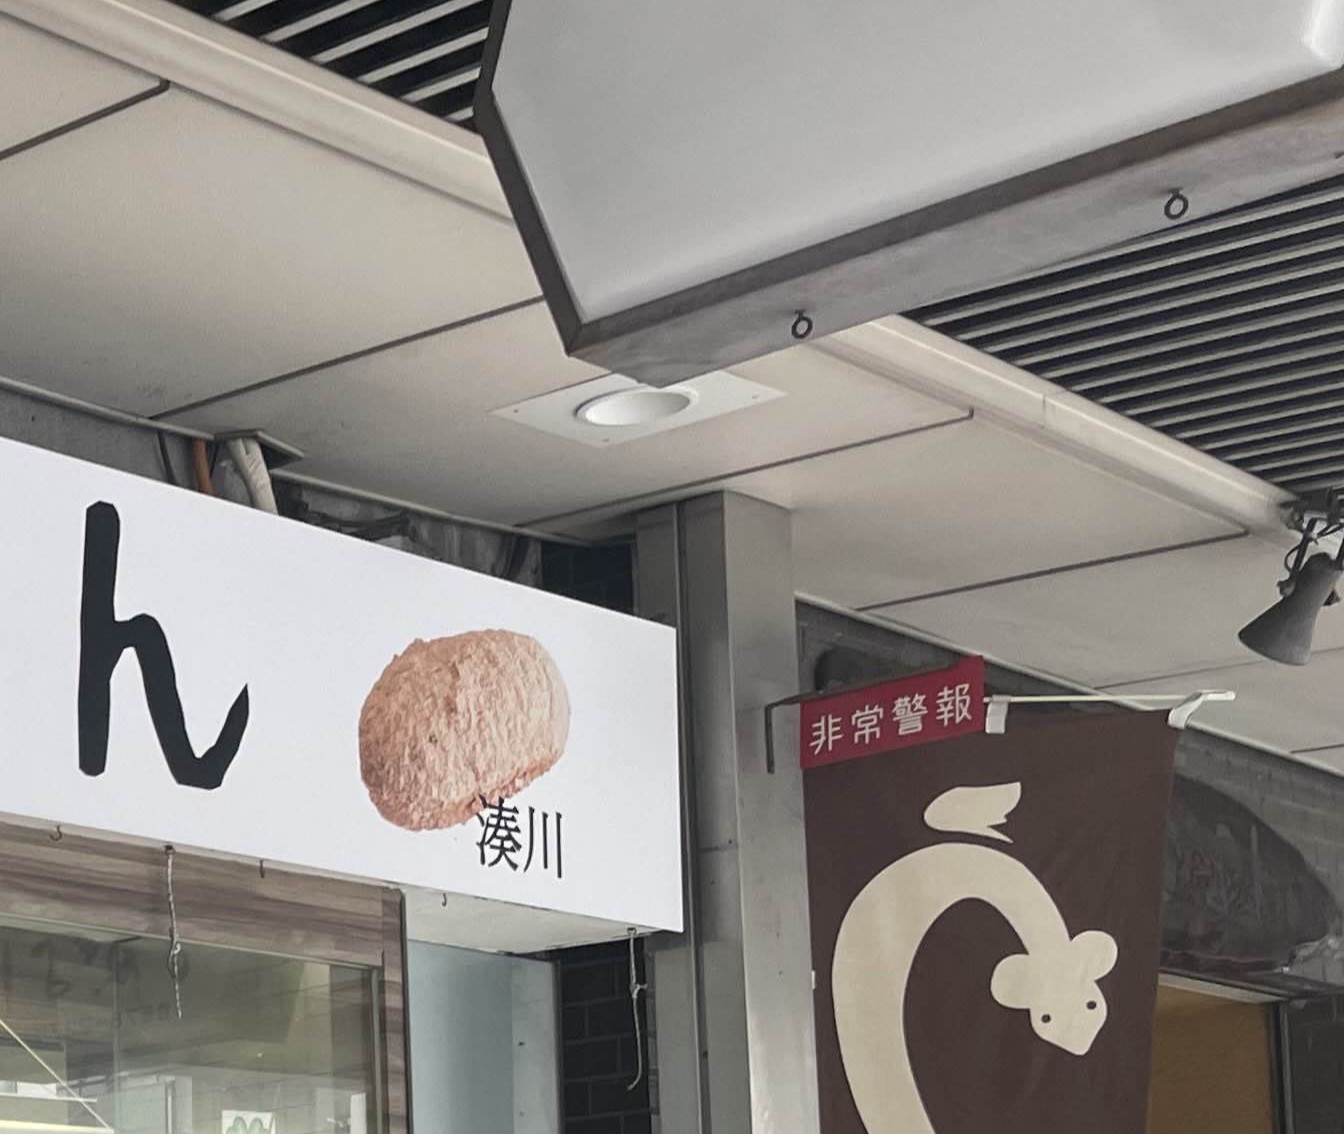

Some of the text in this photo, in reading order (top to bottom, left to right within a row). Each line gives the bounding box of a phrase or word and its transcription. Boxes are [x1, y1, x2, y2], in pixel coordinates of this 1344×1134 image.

[809, 682, 973, 755] 非常警報
[476, 794, 563, 879] 湊川
